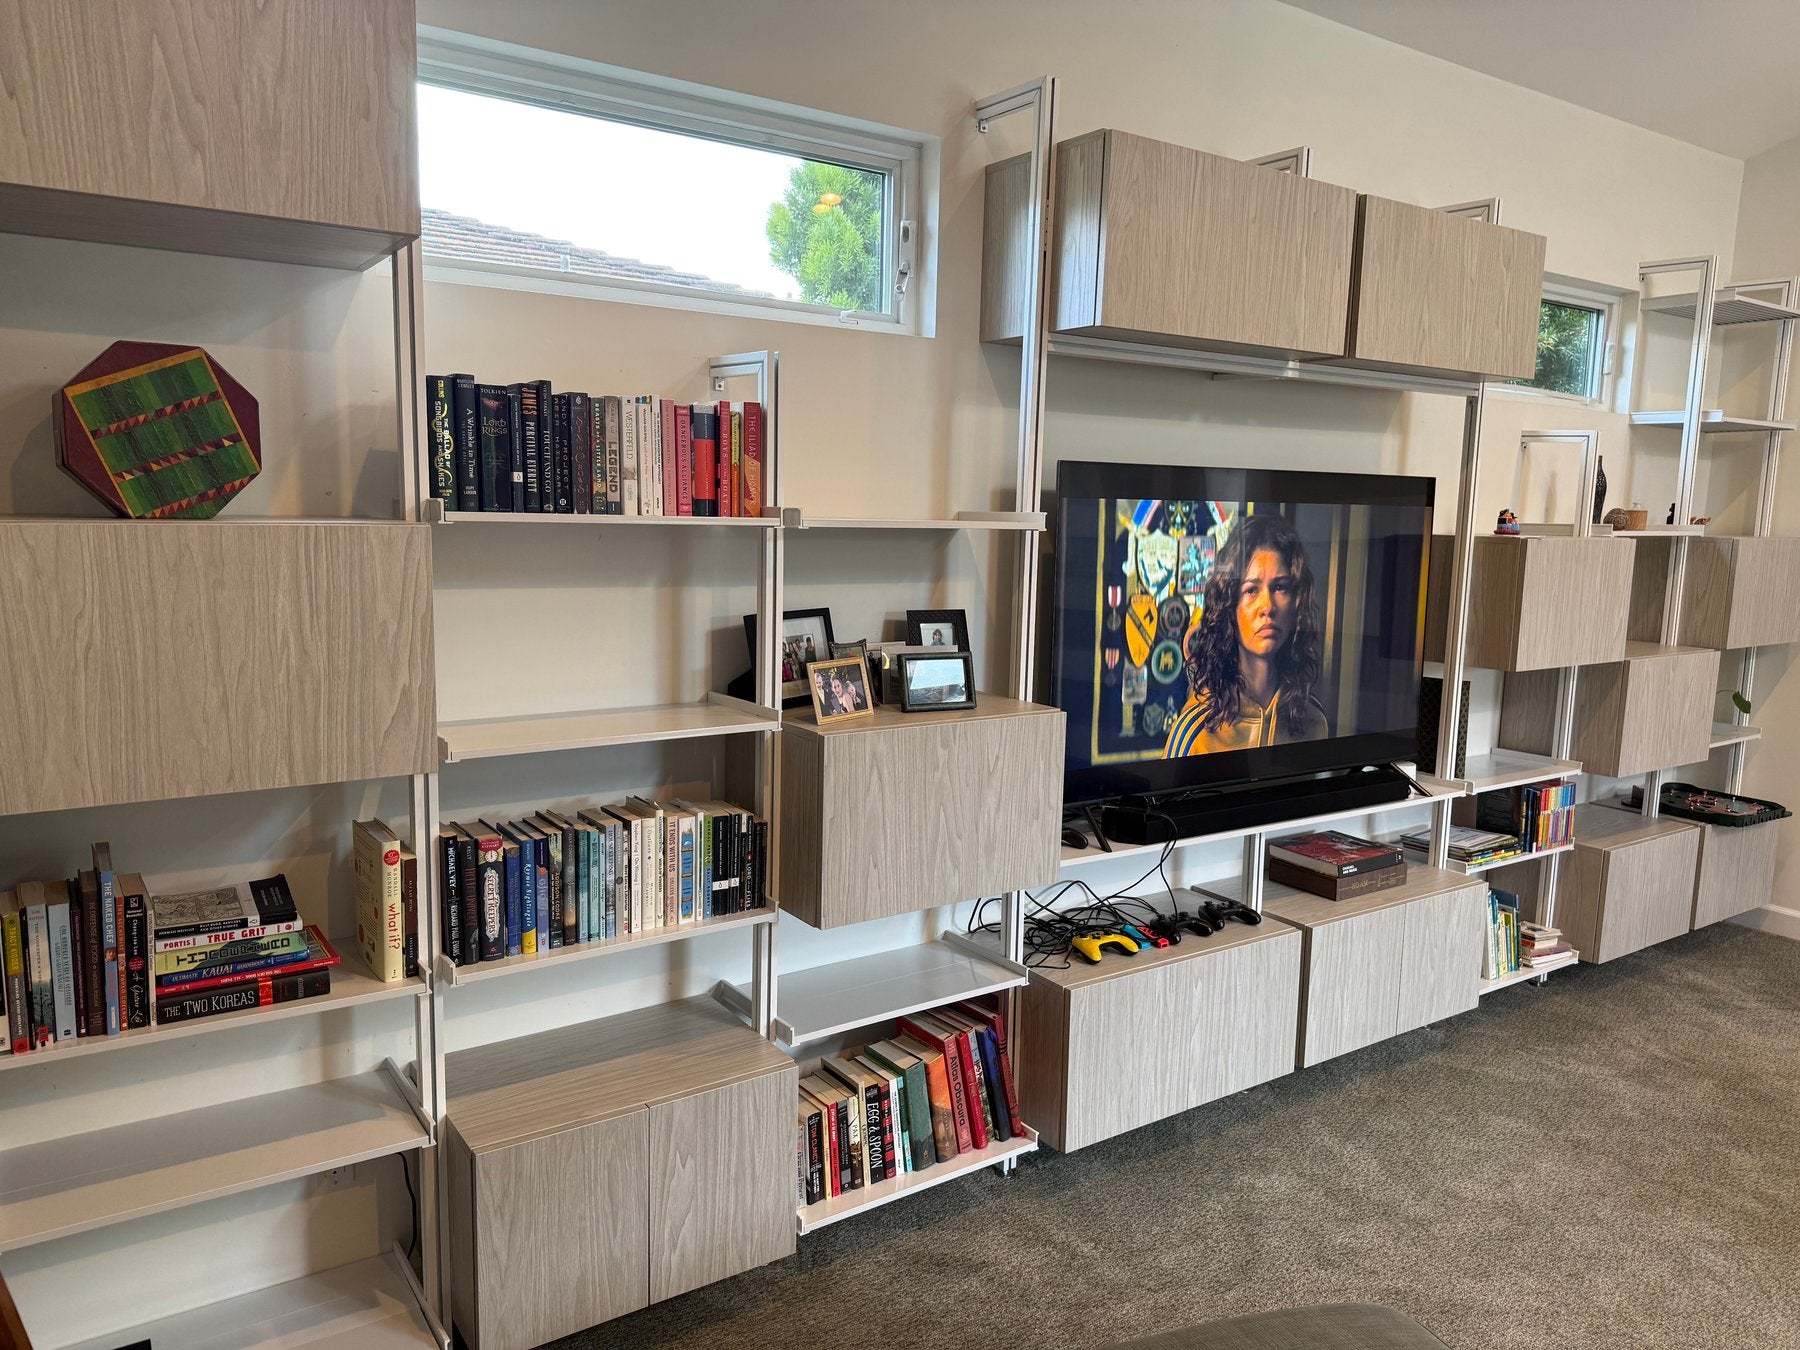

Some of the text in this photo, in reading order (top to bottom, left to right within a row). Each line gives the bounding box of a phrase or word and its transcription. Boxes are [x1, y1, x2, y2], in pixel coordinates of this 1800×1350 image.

[437, 379, 445, 398] COLLINS
[480, 387, 508, 395] TOLKIEN
[521, 387, 538, 416] JAMES
[435, 401, 443, 443] SONGBIRDS
[467, 417, 475, 448] Wrinkle
[625, 411, 634, 460] WESTERFELD
[443, 430, 451, 459] BALLAD
[468, 450, 475, 458] in
[525, 421, 537, 493] PERCIVAL EVERETT
[543, 430, 551, 458] TOUCH
[437, 457, 445, 487] SNAKES
[468, 459, 476, 478] Time
[608, 441, 618, 493] LEGEND
[748, 416, 757, 505] THE ILIAD OF HOMER
[544, 480, 552, 493] GO
[448, 847, 456, 874] MICHAEL
[669, 864, 676, 873] US
[449, 874, 457, 888] VEY
[524, 863, 532, 887] Raymie
[105, 898, 113, 924] NAKED
[486, 875, 497, 934] SECRET KEEPERS
[524, 889, 533, 927] Nightingale
[538, 878, 547, 917] GHOSTS
[89, 910, 97, 938] DEFENSE
[388, 903, 400, 949] what if?
[450, 904, 459, 926] RICHARD
[106, 925, 114, 944] CHEF
[131, 919, 139, 944] Chang-rae
[163, 940, 191, 949] PORTIS
[207, 931, 235, 944] TRUE
[241, 927, 266, 939] GRIT
[451, 927, 460, 939] PAUL
[9, 927, 19, 970] TRACY KIDDER
[452, 939, 461, 956] EVANS
[172, 973, 198, 982] ULTIMATE
[201, 964, 233, 978] KAUAI
[130, 985, 143, 1008] Gesture
[164, 990, 255, 1018] THE TWO KOREAS
[131, 1010, 144, 1024] Life
[949, 1055, 966, 1126] Atlas Obscura
[867, 1102, 883, 1169] EGG & SPOON
